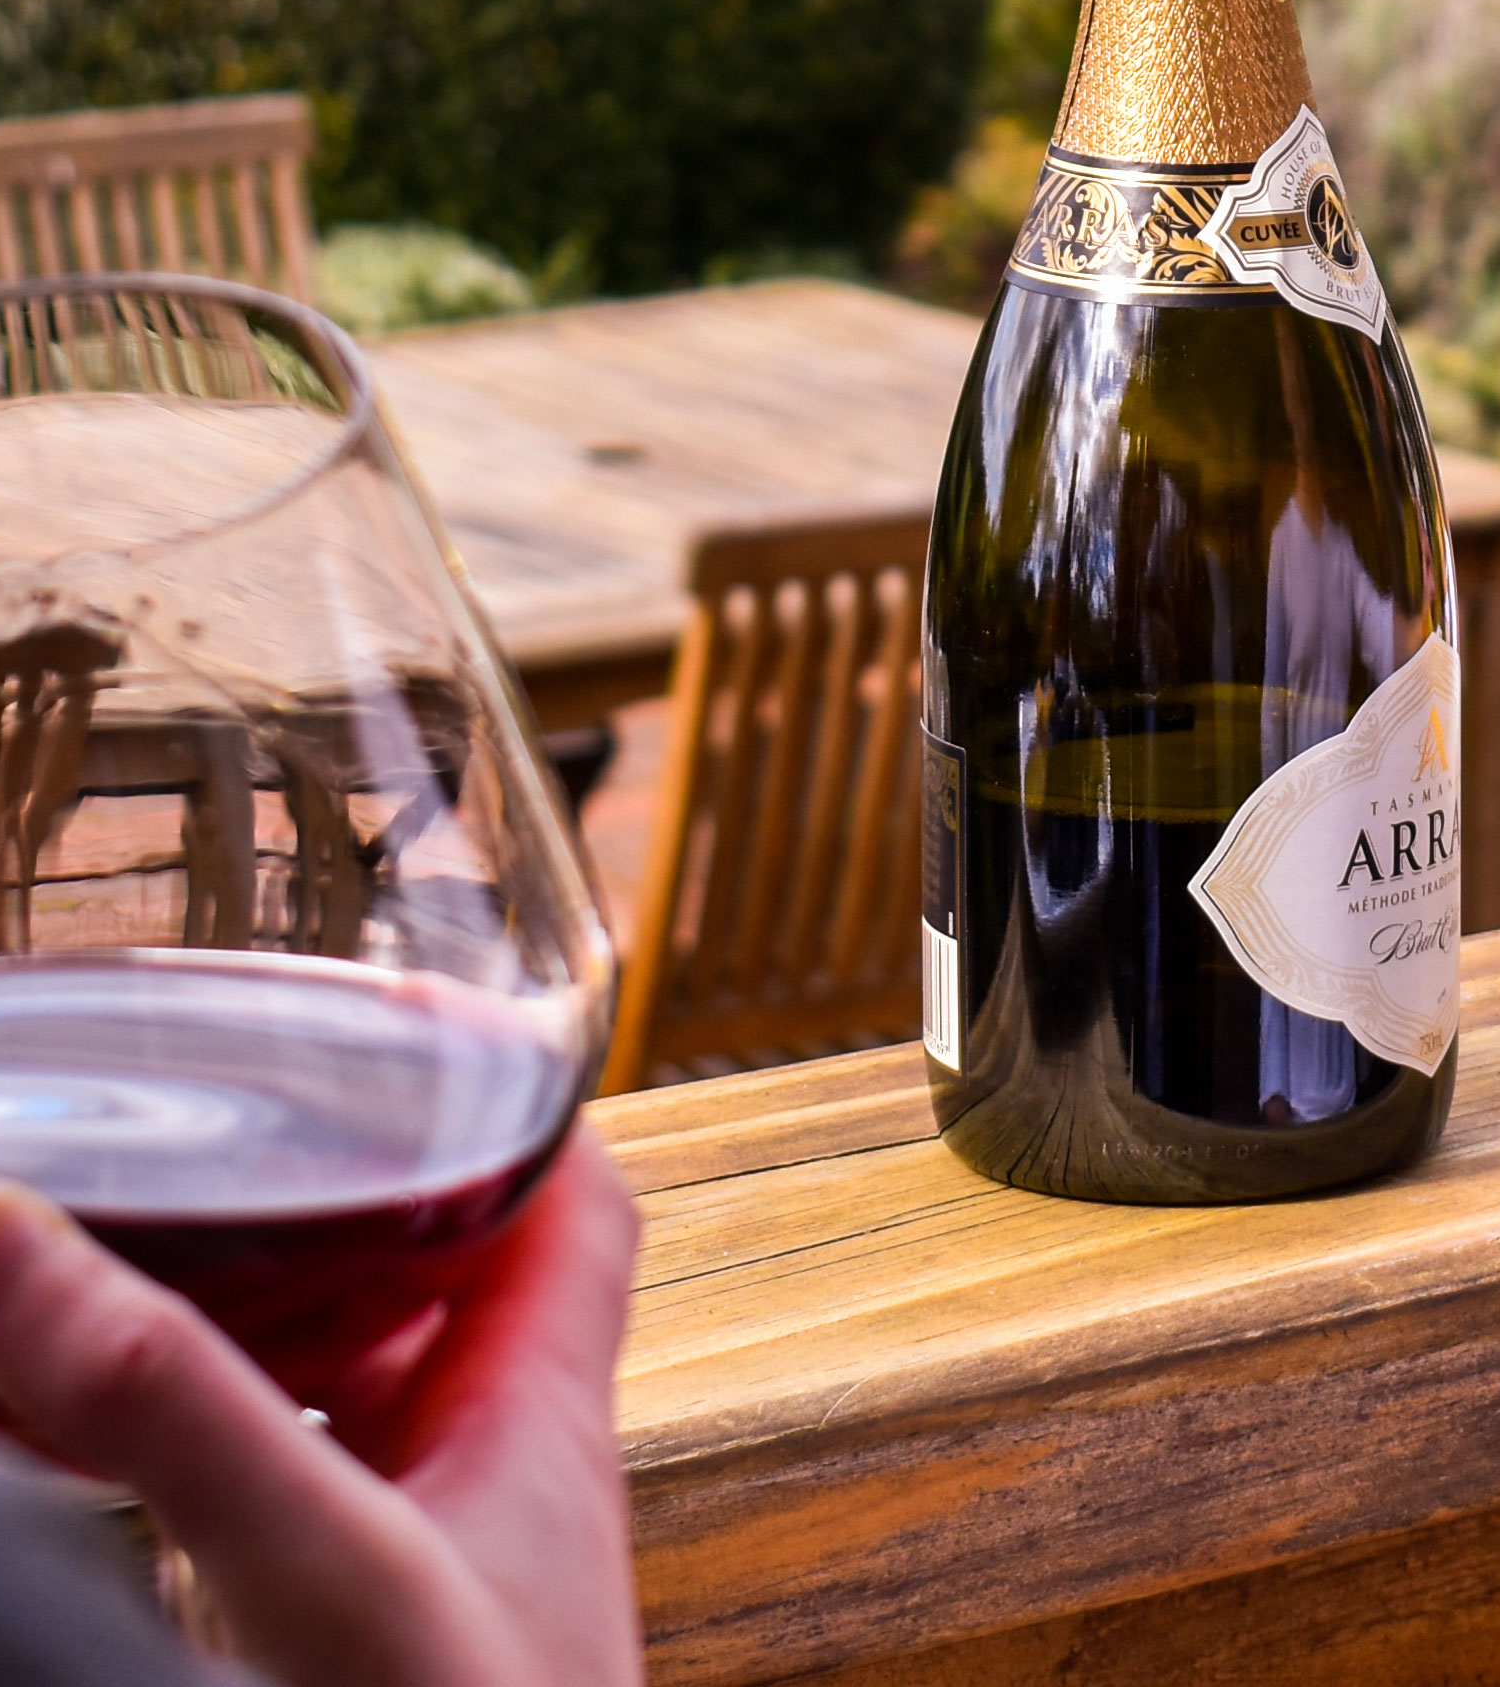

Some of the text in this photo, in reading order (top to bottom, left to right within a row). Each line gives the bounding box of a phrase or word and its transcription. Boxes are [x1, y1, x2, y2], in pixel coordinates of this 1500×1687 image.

[1280, 148, 1310, 201] HOUSE
[1026, 199, 1170, 251] ARRAS
[1240, 218, 1302, 243] CUVÉE
[1326, 280, 1361, 302] BRUT
[1348, 890, 1417, 915] MÉTHODE
